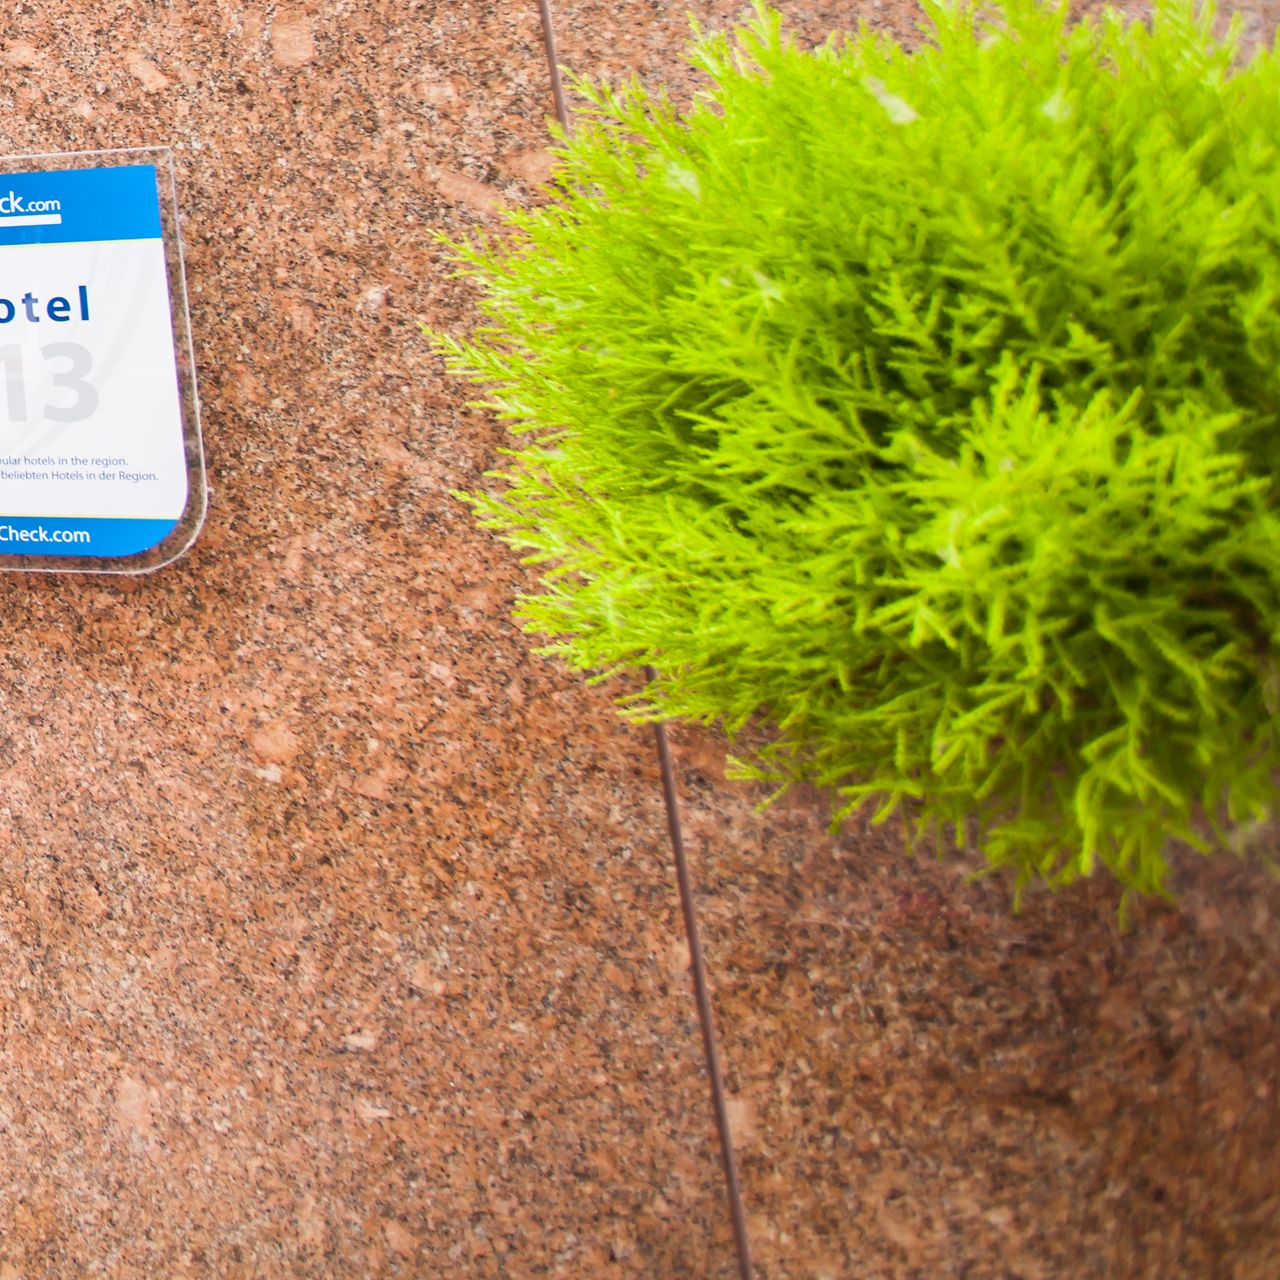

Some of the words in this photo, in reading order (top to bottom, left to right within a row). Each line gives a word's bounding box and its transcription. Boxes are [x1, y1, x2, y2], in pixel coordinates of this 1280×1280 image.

[24, 456, 56, 466] hotels
[58, 456, 68, 466] in
[71, 456, 88, 466] the
[91, 456, 129, 468] region.
[1, 470, 48, 480] beliebten
[51, 471, 84, 480] Hotels
[86, 471, 96, 480] in
[99, 471, 116, 481] der
[119, 471, 159, 483] Region.
